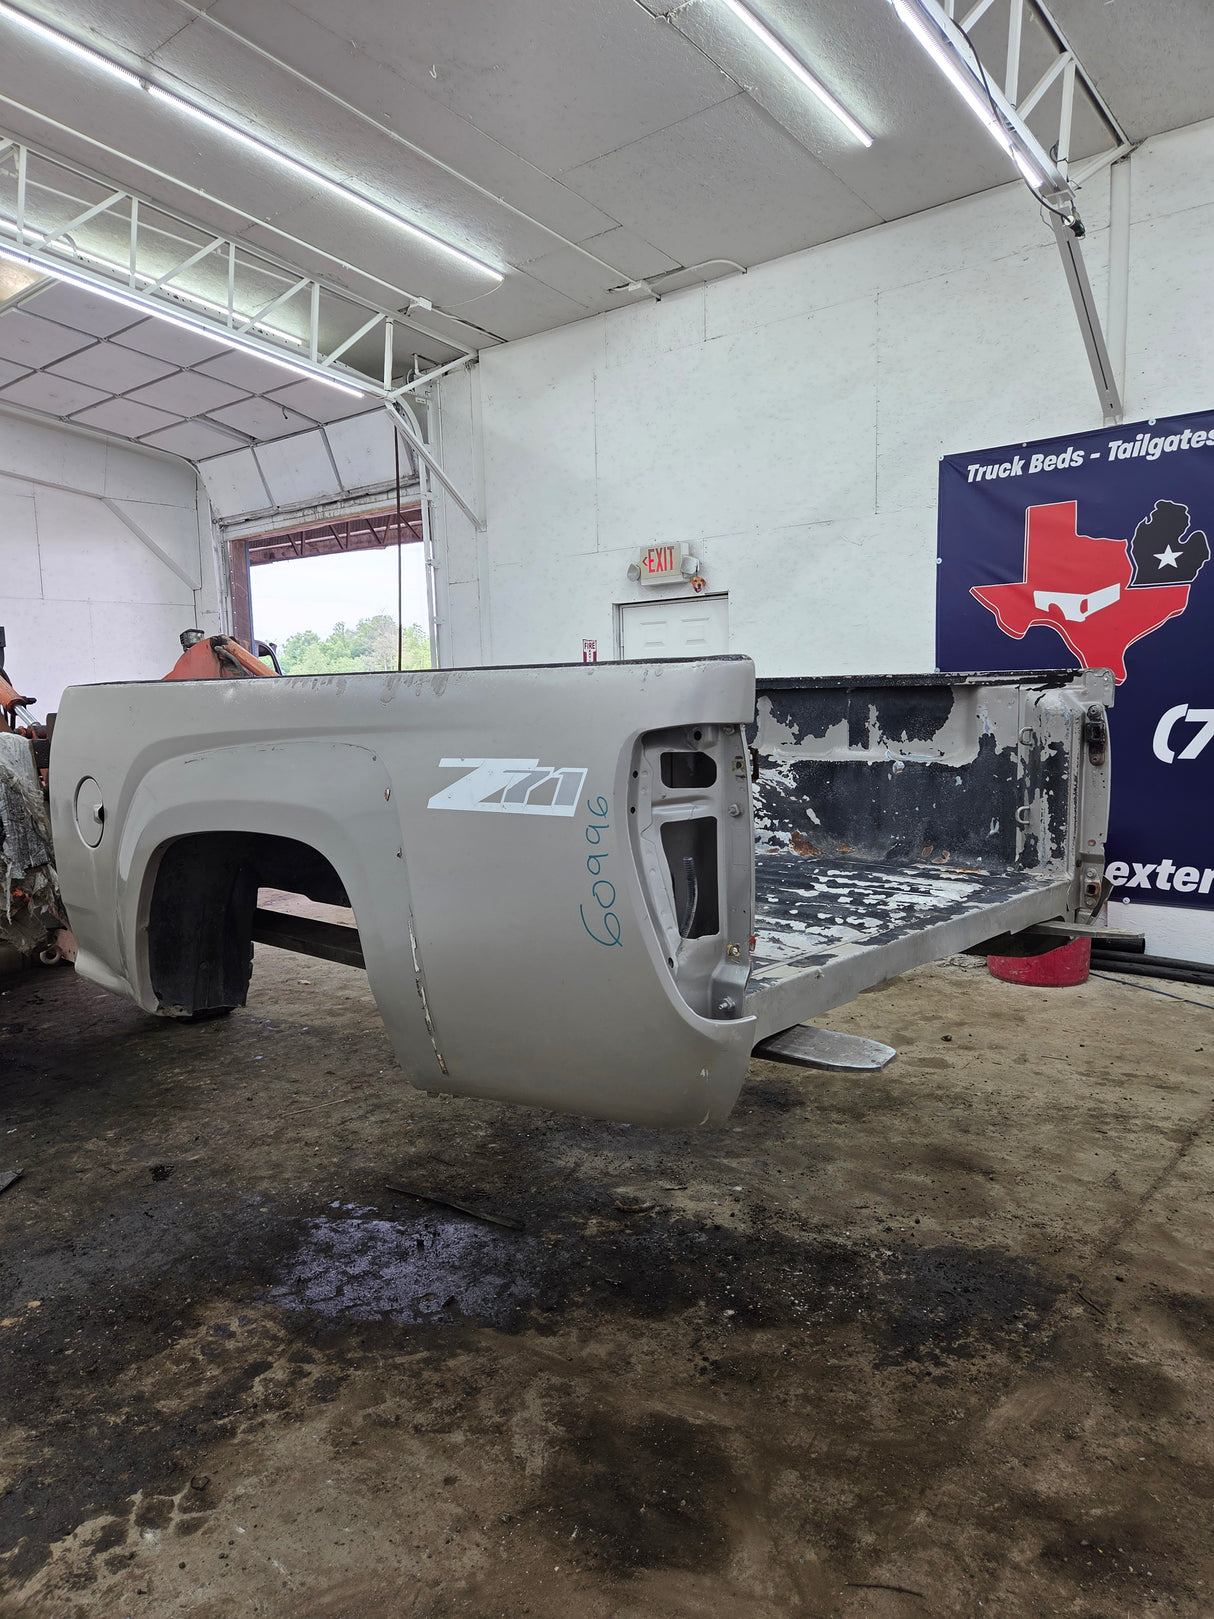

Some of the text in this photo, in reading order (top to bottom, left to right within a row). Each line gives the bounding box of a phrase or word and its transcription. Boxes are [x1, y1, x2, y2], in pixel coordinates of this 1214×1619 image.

[967, 456, 1024, 483] Truck
[1029, 447, 1083, 473] Beds
[1108, 429, 1214, 461] Tailgates
[648, 546, 674, 573] EXIT
[584, 642, 596, 650] FIRE
[427, 758, 588, 817] Z71
[580, 796, 623, 947] 60996
